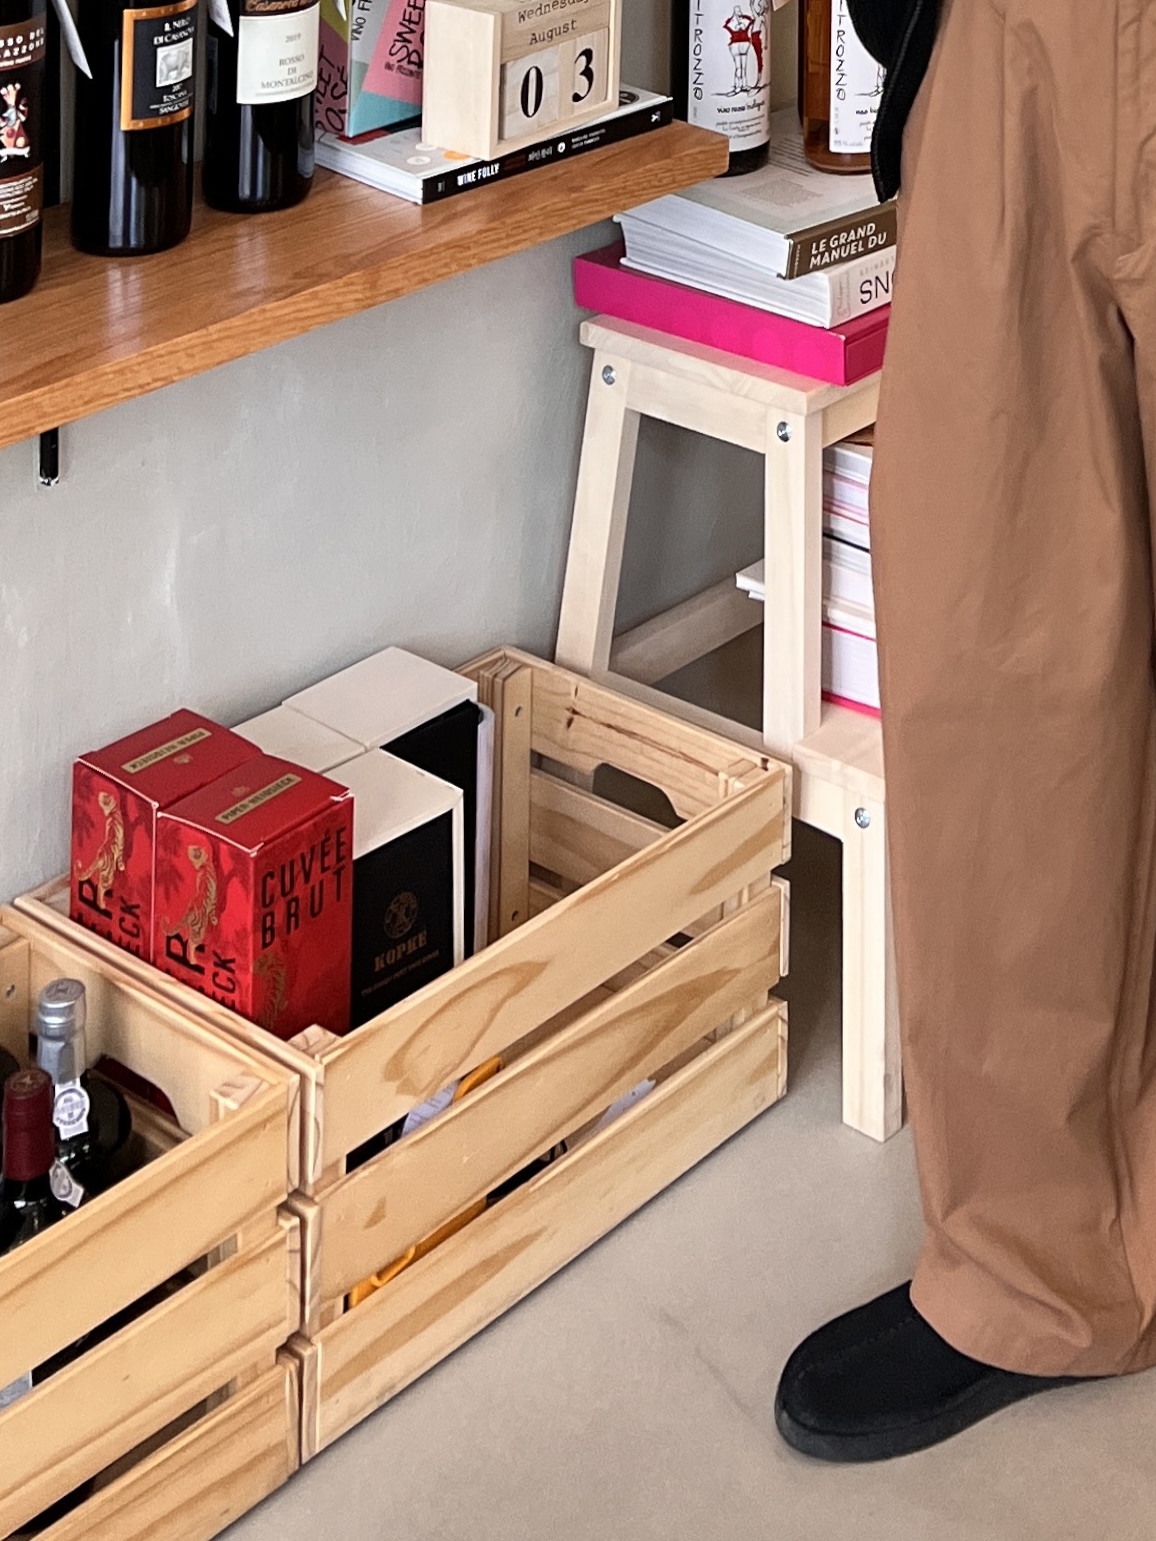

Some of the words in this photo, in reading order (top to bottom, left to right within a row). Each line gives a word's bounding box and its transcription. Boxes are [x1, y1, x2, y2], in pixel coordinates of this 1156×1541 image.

[350, 17, 367, 41] VINO
[528, 17, 578, 46] August
[279, 54, 305, 66] ROSSO
[287, 67, 297, 75] DI
[261, 70, 314, 89] MONTALCINO
[520, 65, 544, 119] 0
[571, 47, 594, 103] 3
[457, 169, 476, 186] WINE
[477, 162, 500, 181] FOLLY
[809, 240, 865, 270] MANUEL
[868, 232, 887, 249] DU
[811, 238, 827, 255] LE
[829, 222, 876, 248] GRAND
[261, 826, 347, 909] CUVÉE
[261, 865, 346, 950] BRUT
[373, 930, 428, 973] KOPKE
